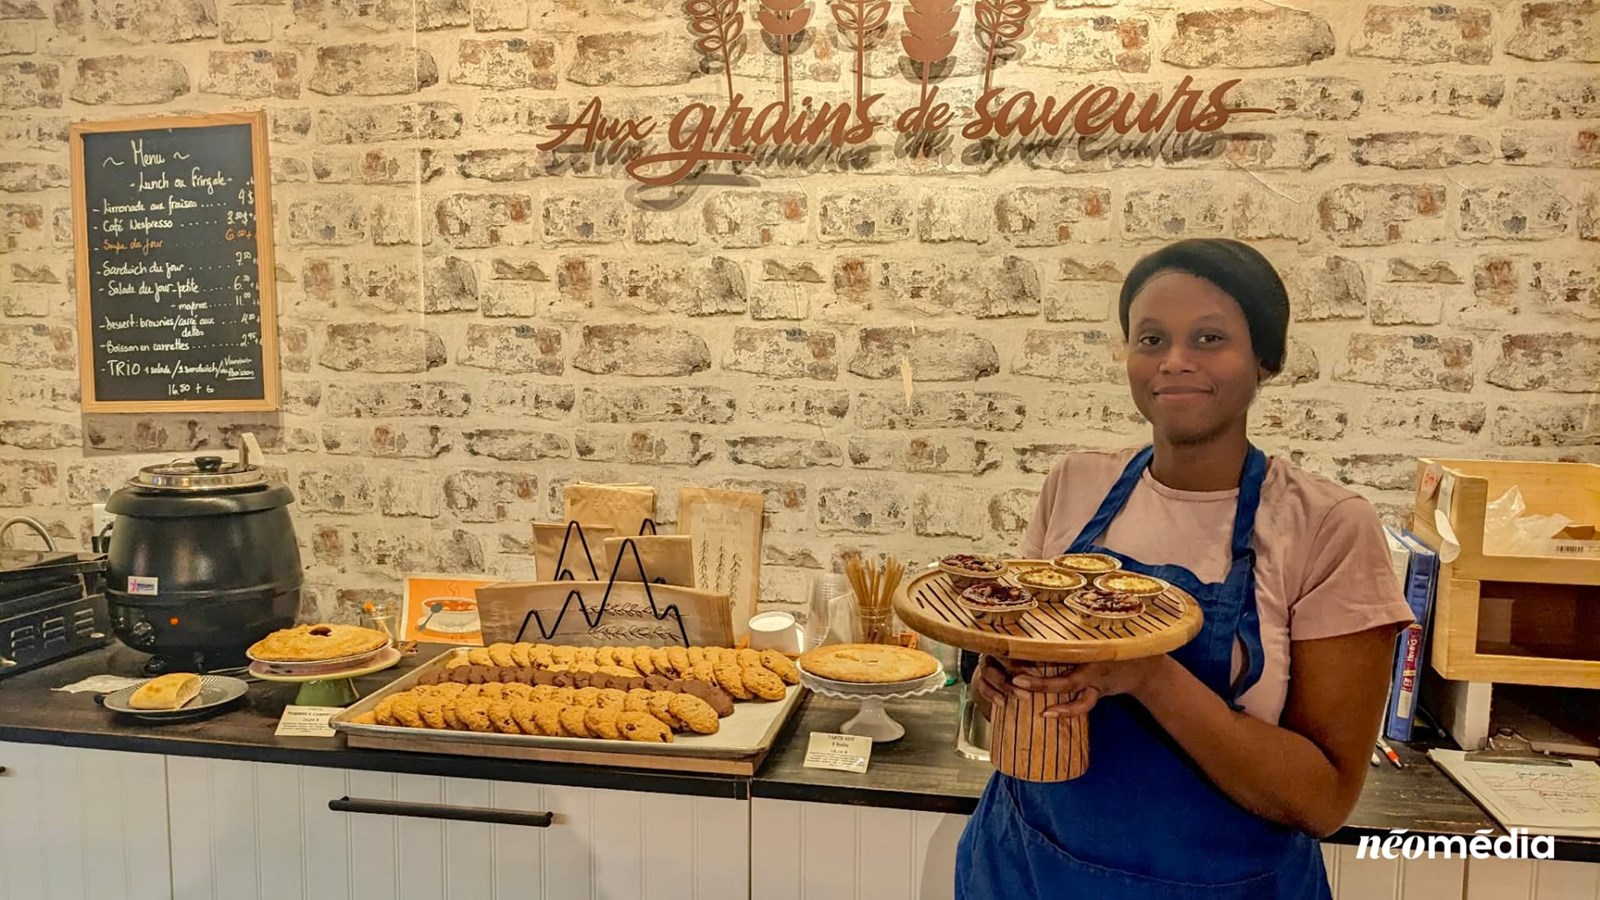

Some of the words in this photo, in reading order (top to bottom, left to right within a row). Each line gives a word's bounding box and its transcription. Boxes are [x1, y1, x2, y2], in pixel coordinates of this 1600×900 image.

[535, 99, 656, 152] Aux
[625, 95, 886, 186] grains
[896, 85, 956, 132] de
[962, 75, 1276, 142] saveurs
[131, 138, 165, 167] Menu
[103, 217, 124, 237] Café
[130, 216, 173, 235] Nespresso
